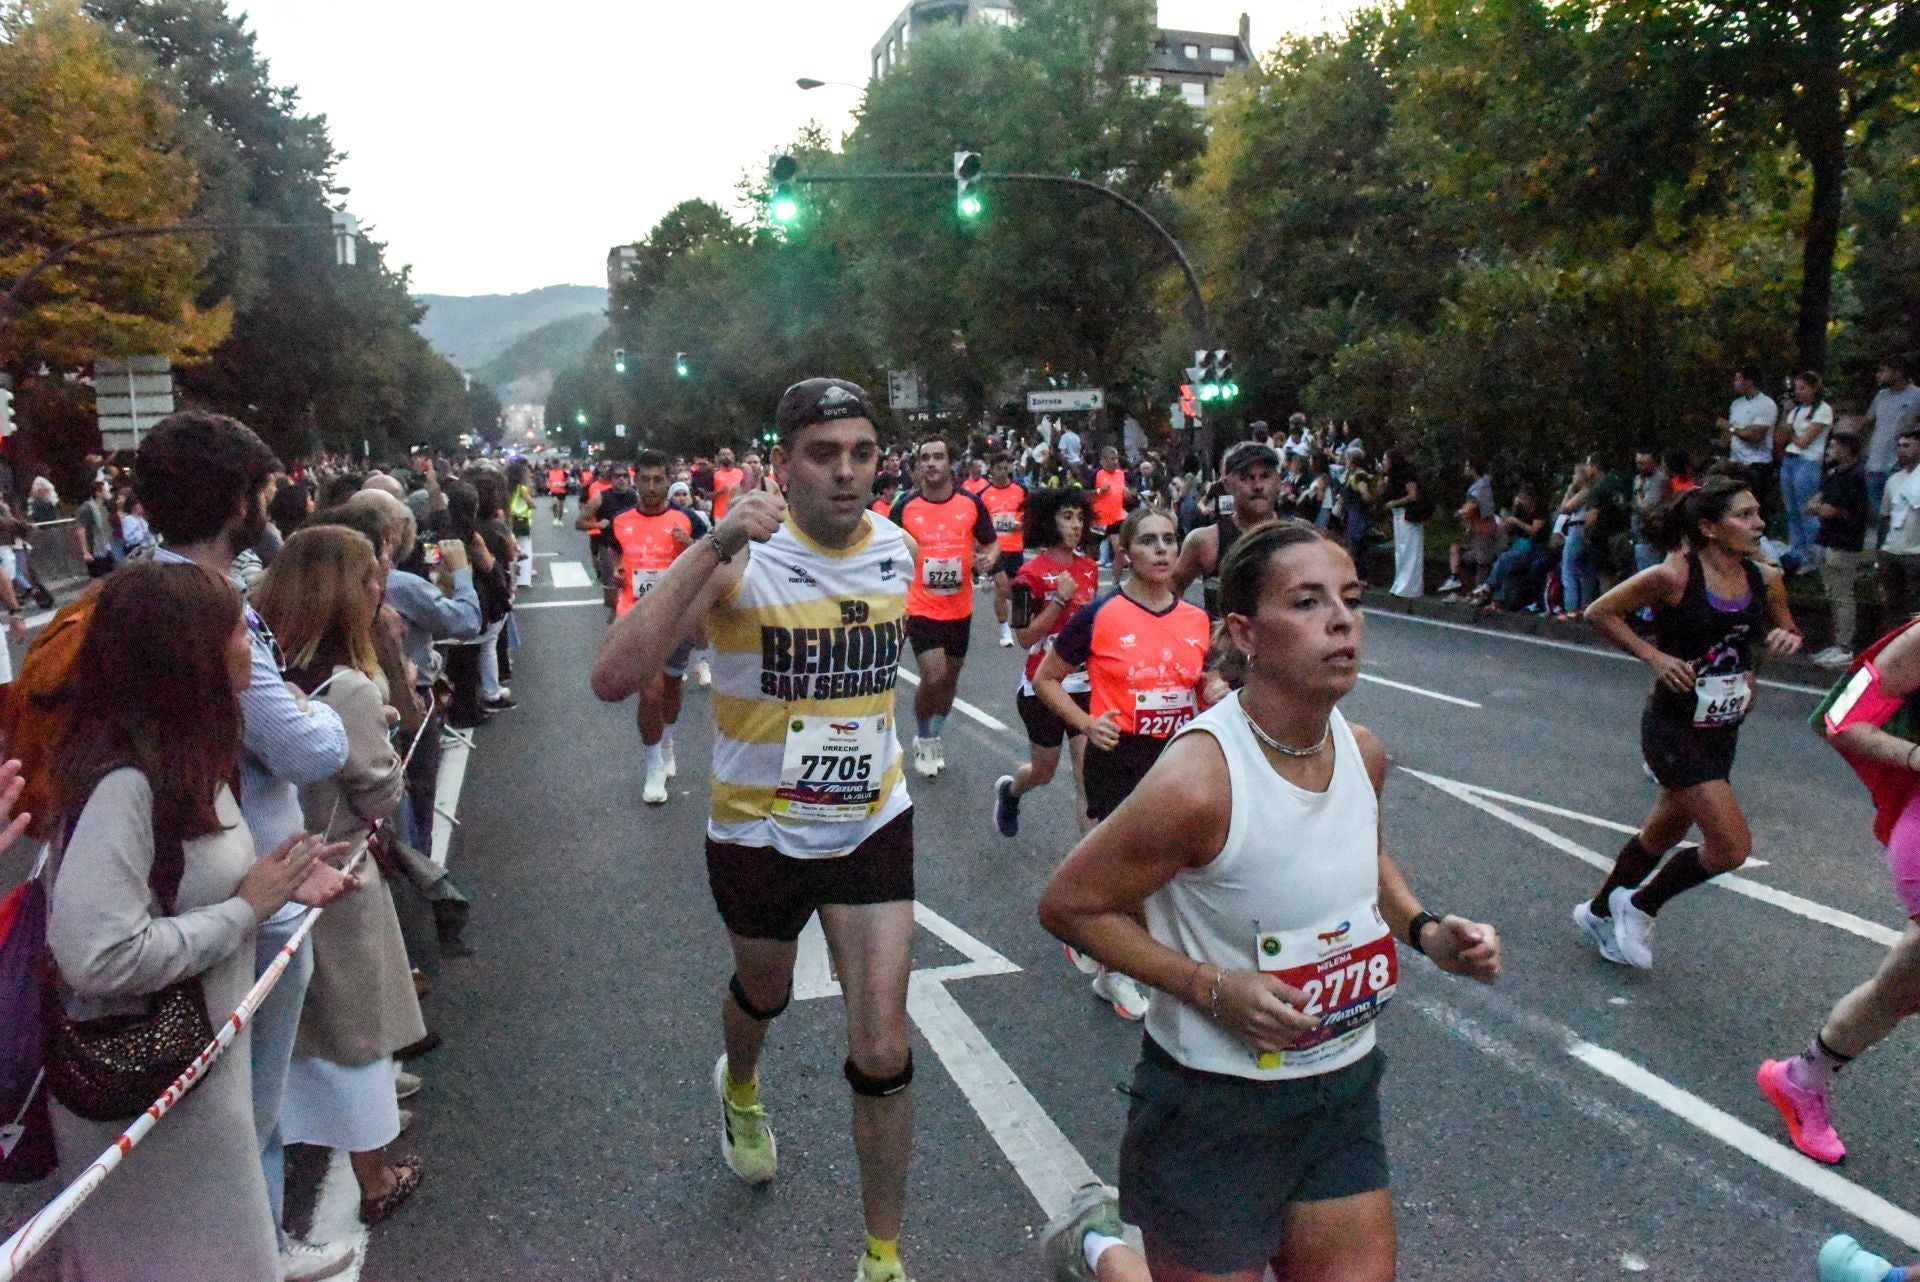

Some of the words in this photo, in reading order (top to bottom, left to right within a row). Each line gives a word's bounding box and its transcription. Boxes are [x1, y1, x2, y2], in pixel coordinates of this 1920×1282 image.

[840, 600, 869, 624] 59
[761, 671, 810, 700] SAN
[801, 754, 872, 781] 7705
[1317, 953, 1352, 973] HELENA
[1302, 953, 1389, 1016] 2778
